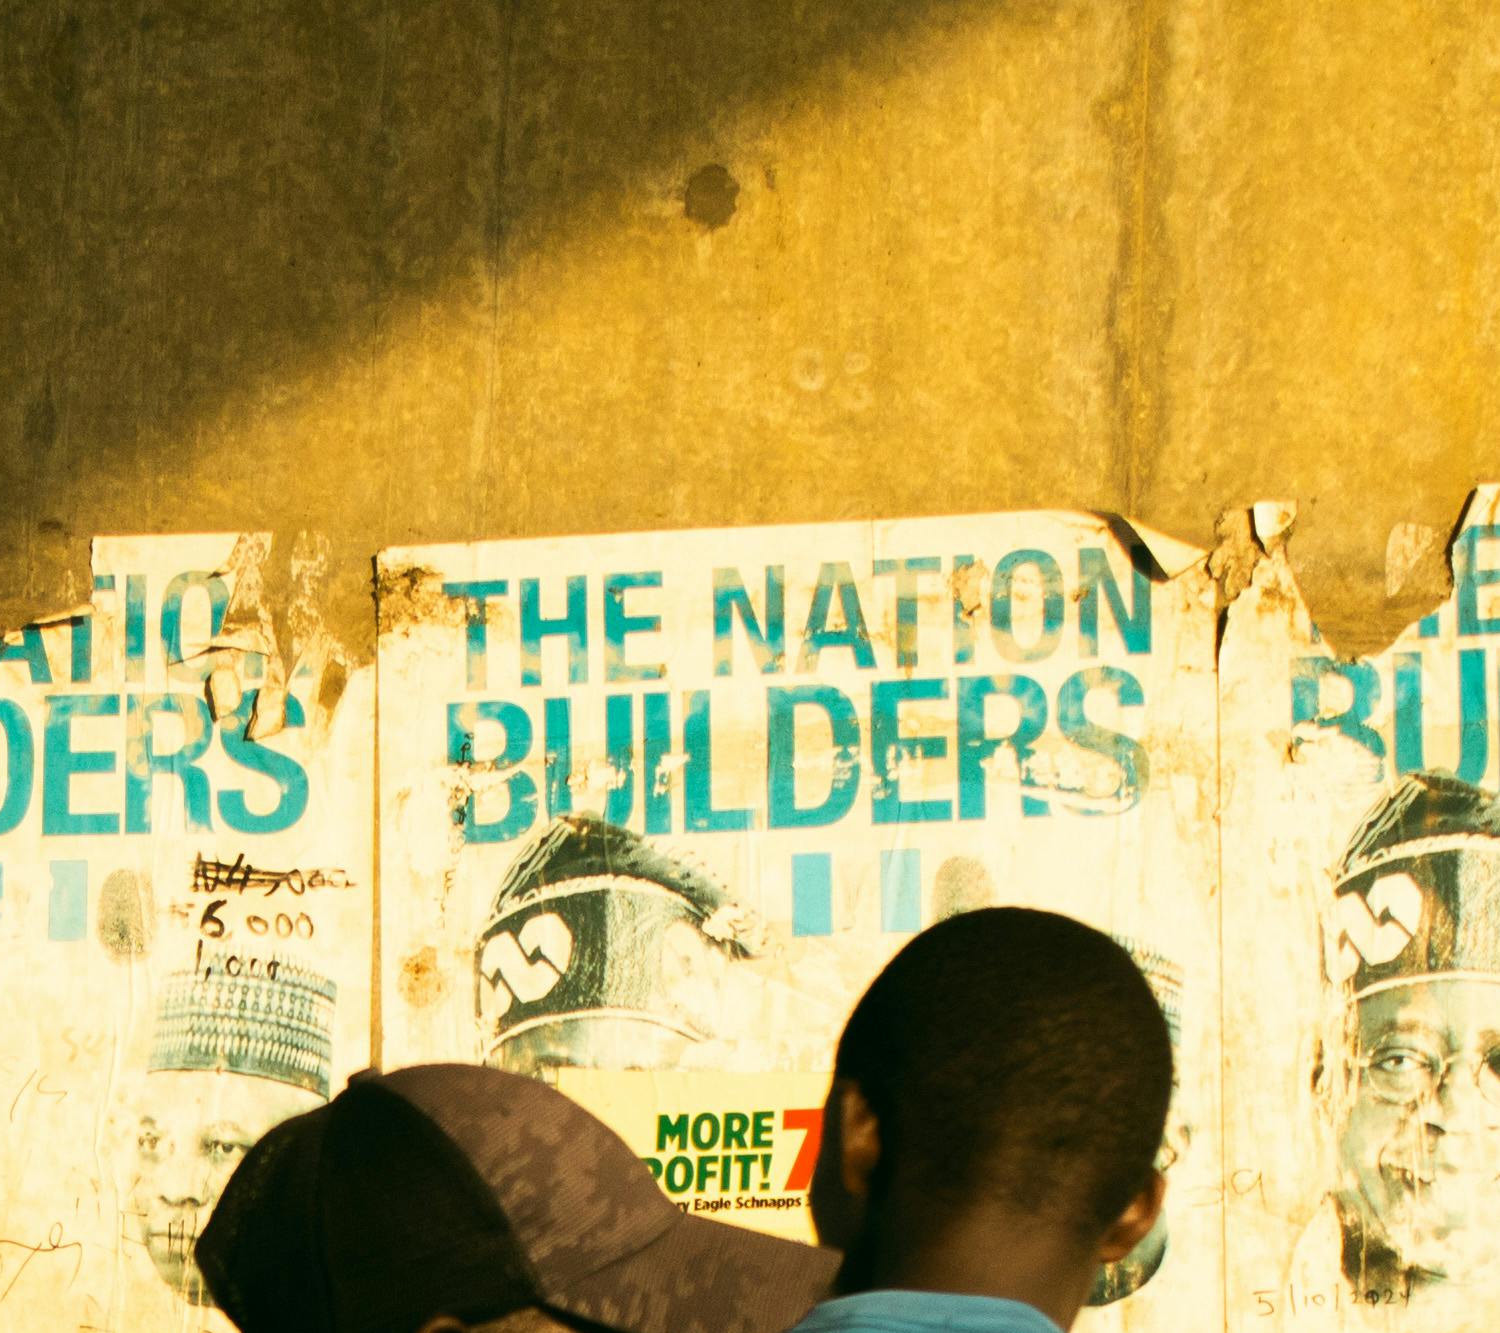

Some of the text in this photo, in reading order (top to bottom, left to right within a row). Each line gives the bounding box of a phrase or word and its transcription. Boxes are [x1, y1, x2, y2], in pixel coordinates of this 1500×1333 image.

[443, 548, 1152, 690] THE NATION
[446, 667, 1150, 845] BUILDERS
[656, 1111, 775, 1152] MORE
[694, 1198, 731, 1212] Eagle
[735, 1196, 802, 1212] Schnapps
